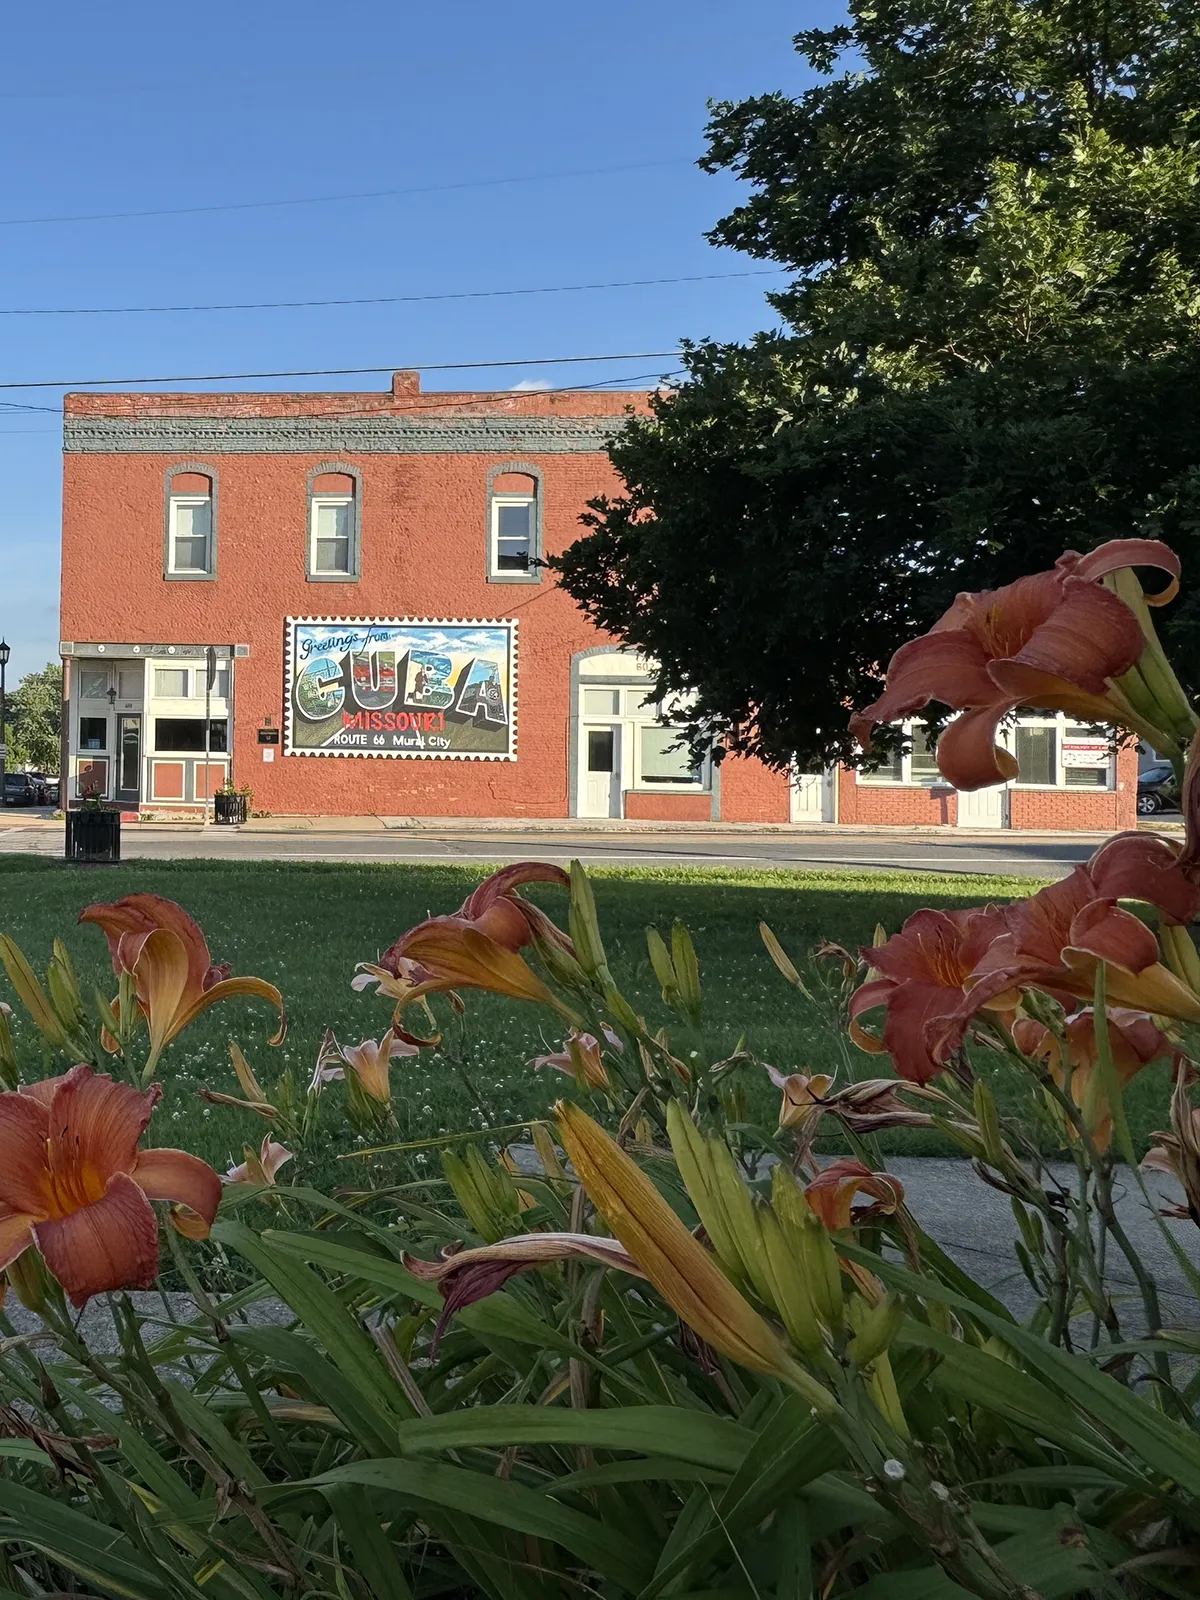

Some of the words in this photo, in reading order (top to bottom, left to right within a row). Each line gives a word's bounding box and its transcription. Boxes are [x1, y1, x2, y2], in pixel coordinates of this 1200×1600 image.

[300, 632, 359, 660] Greetings
[293, 649, 509, 728] CUBA
[341, 711, 445, 732] MISSOURI
[334, 734, 367, 745] ROUTE
[373, 734, 386, 745] 66
[393, 735, 425, 747] Mural
[428, 736, 451, 749] City
